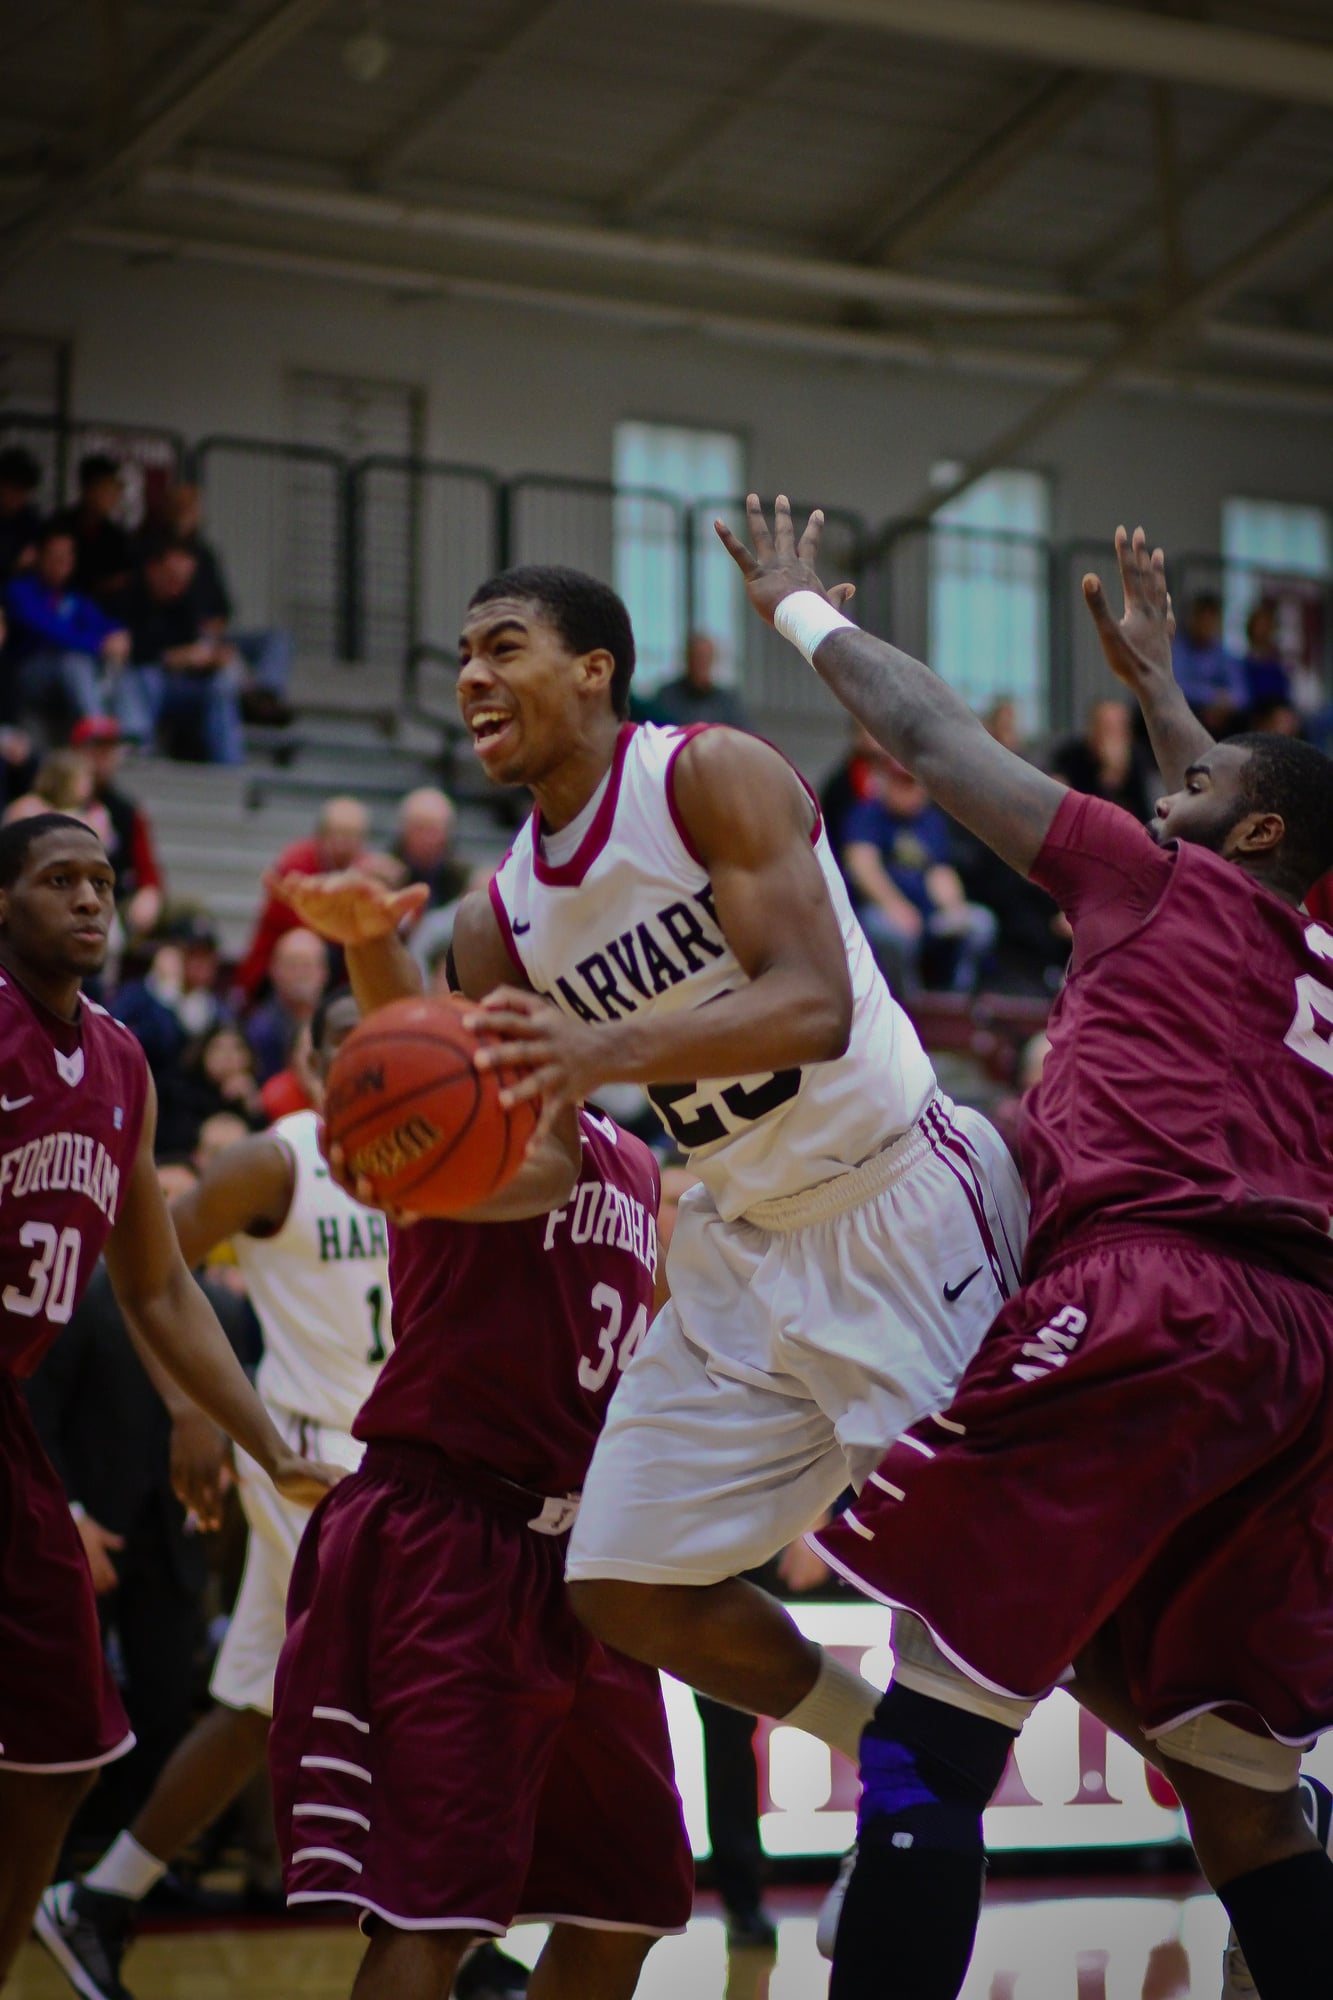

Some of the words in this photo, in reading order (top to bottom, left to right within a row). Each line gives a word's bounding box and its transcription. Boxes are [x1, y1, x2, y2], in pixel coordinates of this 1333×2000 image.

[546, 881, 725, 1023] ARVAR
[0, 1131, 121, 1226] FORDHAM
[1, 1220, 82, 1325] 30
